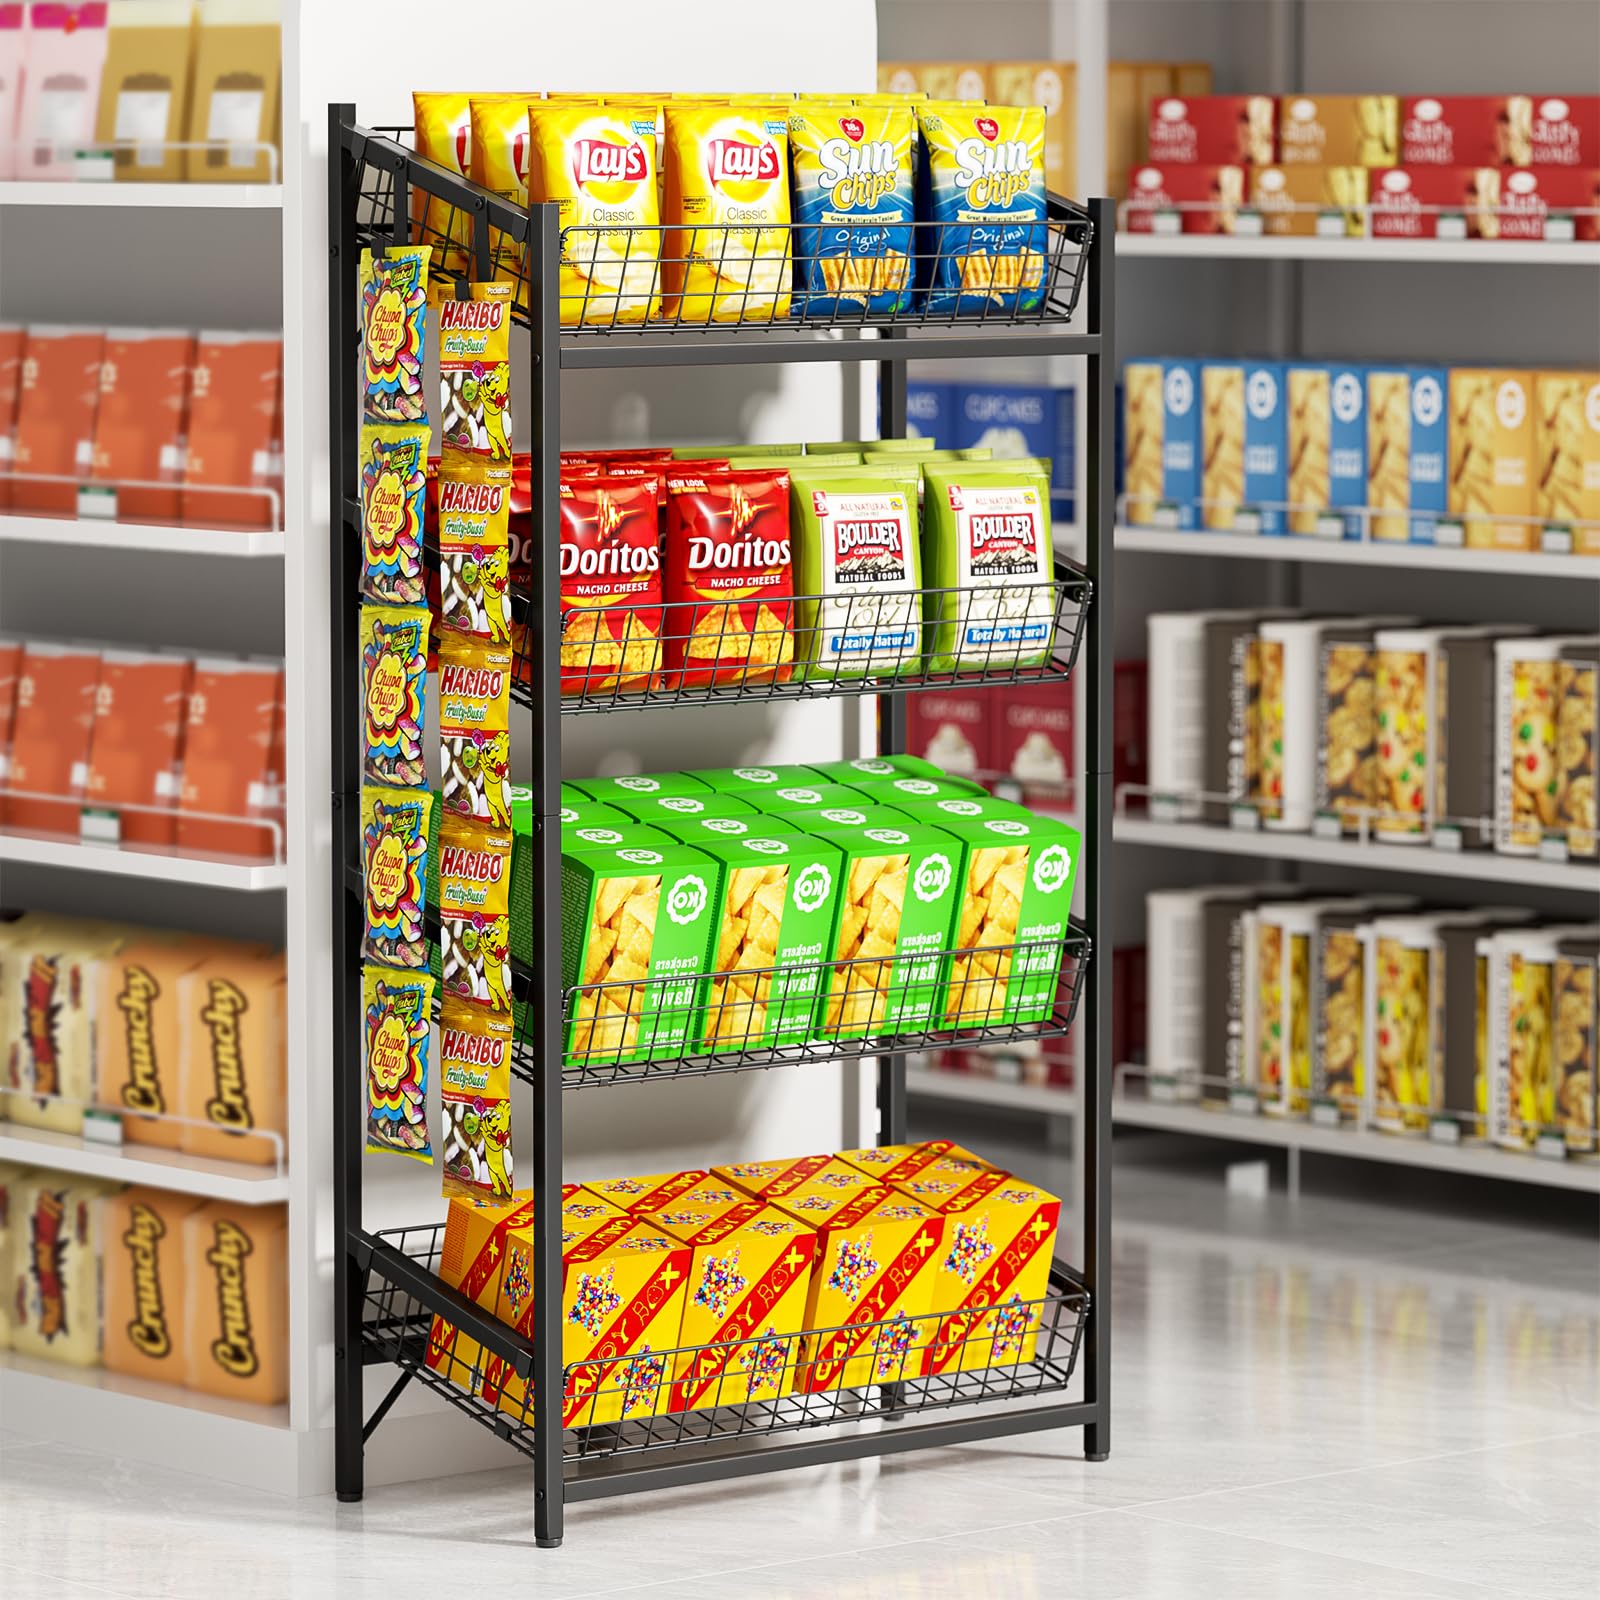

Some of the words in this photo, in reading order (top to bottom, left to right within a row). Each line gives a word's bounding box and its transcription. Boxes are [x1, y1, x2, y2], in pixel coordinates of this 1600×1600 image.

[578, 140, 642, 182] Lay's
[713, 140, 774, 182] Lay's
[818, 138, 899, 189] Sun
[954, 137, 1033, 189] Sun
[592, 207, 635, 222] Classic
[726, 206, 768, 221] Classic
[835, 228, 891, 252] Original
[971, 226, 1025, 250] Original
[374, 305, 402, 327] Chupa
[440, 300, 503, 330] HARIBO
[370, 324, 398, 345] Chups
[444, 334, 488, 357] Fruity-Bussi
[667, 480, 685, 489] NEW
[686, 479, 706, 488] LOOK
[374, 487, 401, 509] Chupa
[440, 481, 502, 513] HARIBO
[840, 502, 853, 511] ALL
[853, 502, 889, 511] NATURAL
[976, 497, 988, 505] ALL
[989, 496, 1022, 505] NATURAL
[370, 505, 398, 527] Chups
[444, 516, 487, 540] Fruity-Bussi
[837, 521, 900, 554] BOULDER
[972, 515, 1034, 547] BOULDER
[688, 533, 791, 569] Doritos
[853, 547, 884, 555] CANYON
[988, 540, 1018, 549] CANYON
[560, 539, 659, 576] Doritos
[711, 577, 744, 588] NACHO
[746, 575, 781, 587] CHEESE
[839, 573, 874, 583] NATURAL
[877, 572, 902, 581] FOODS
[974, 567, 1009, 576] NATURAL
[1011, 565, 1036, 574] FOODS
[576, 584, 610, 595] NACHO
[613, 582, 649, 593] CHEESE
[835, 586, 911, 608] Olive
[852, 606, 900, 630] Oil
[836, 636, 872, 650] Totally
[873, 634, 913, 648] Natural
[971, 629, 1006, 642] Totally
[374, 669, 402, 692] Chupa
[440, 665, 503, 698] HARIBO
[371, 688, 398, 709] Chups
[444, 700, 488, 724] Fruity-Bussi
[376, 850, 403, 873] Chupa
[440, 846, 503, 882] HARIBO
[372, 869, 399, 890] Chups
[444, 882, 488, 906] Fruity-Bussi
[118, 966, 165, 1117] Crunchy
[378, 1030, 404, 1054] Chupa
[442, 1029, 504, 1067] HARIBO
[201, 979, 253, 1134] Crunchy
[373, 1050, 401, 1072] Chups
[445, 1065, 488, 1090] Fruity-Bussi
[124, 1204, 170, 1358] Crunchy
[934, 1267, 1001, 1362] CANDY
[1004, 1213, 1050, 1275] BOX
[208, 1219, 258, 1376] Crunchy
[633, 1262, 680, 1327] BOX
[816, 1284, 886, 1381] CANDY
[889, 1229, 935, 1292] BOX
[682, 1301, 754, 1399] CANDY
[757, 1246, 805, 1309] BOX
